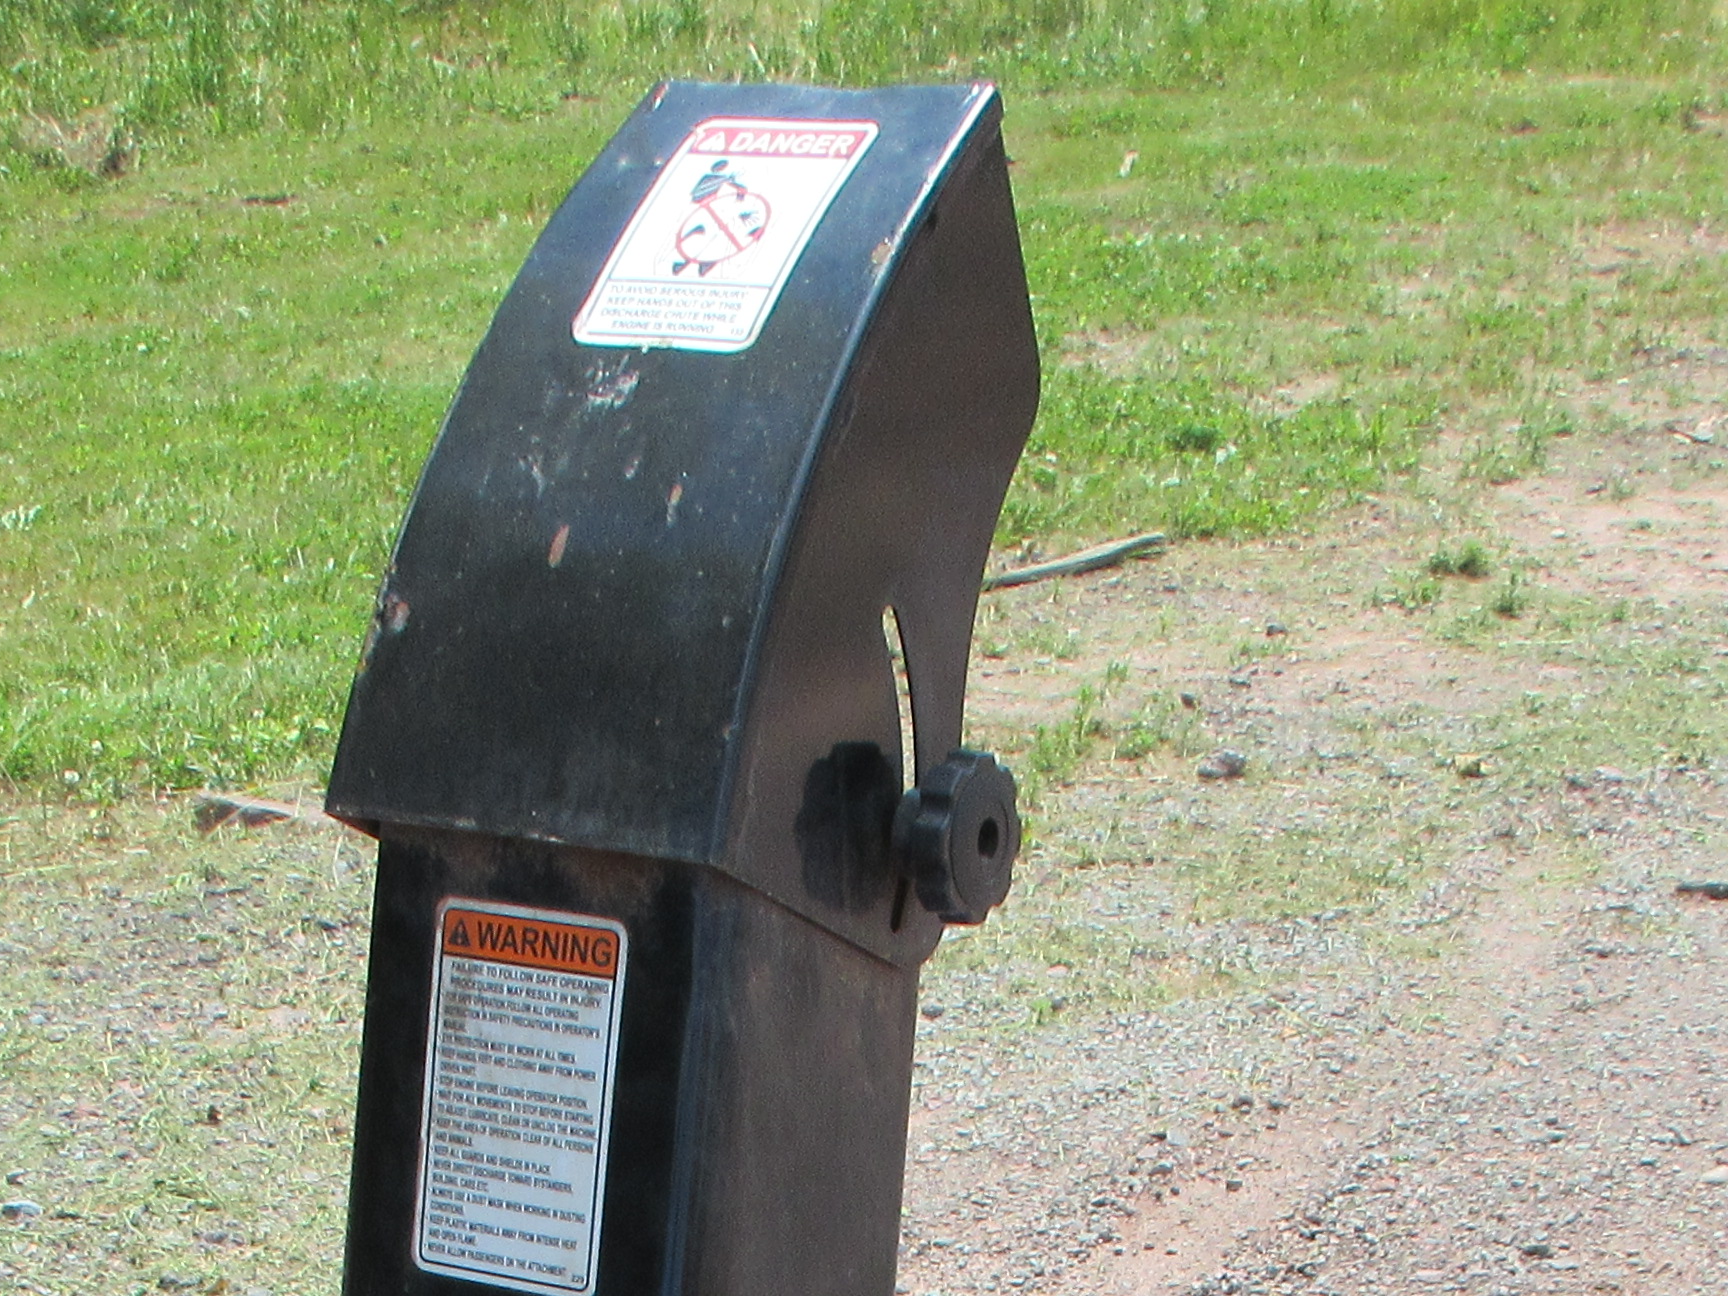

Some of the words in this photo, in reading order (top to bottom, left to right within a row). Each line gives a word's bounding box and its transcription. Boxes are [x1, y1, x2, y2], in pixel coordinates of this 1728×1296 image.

[730, 131, 857, 156] DANGER
[607, 297, 636, 305] KEEP
[676, 299, 698, 308] OUT
[664, 311, 699, 319] CHUTE
[477, 920, 612, 967] WARNING
